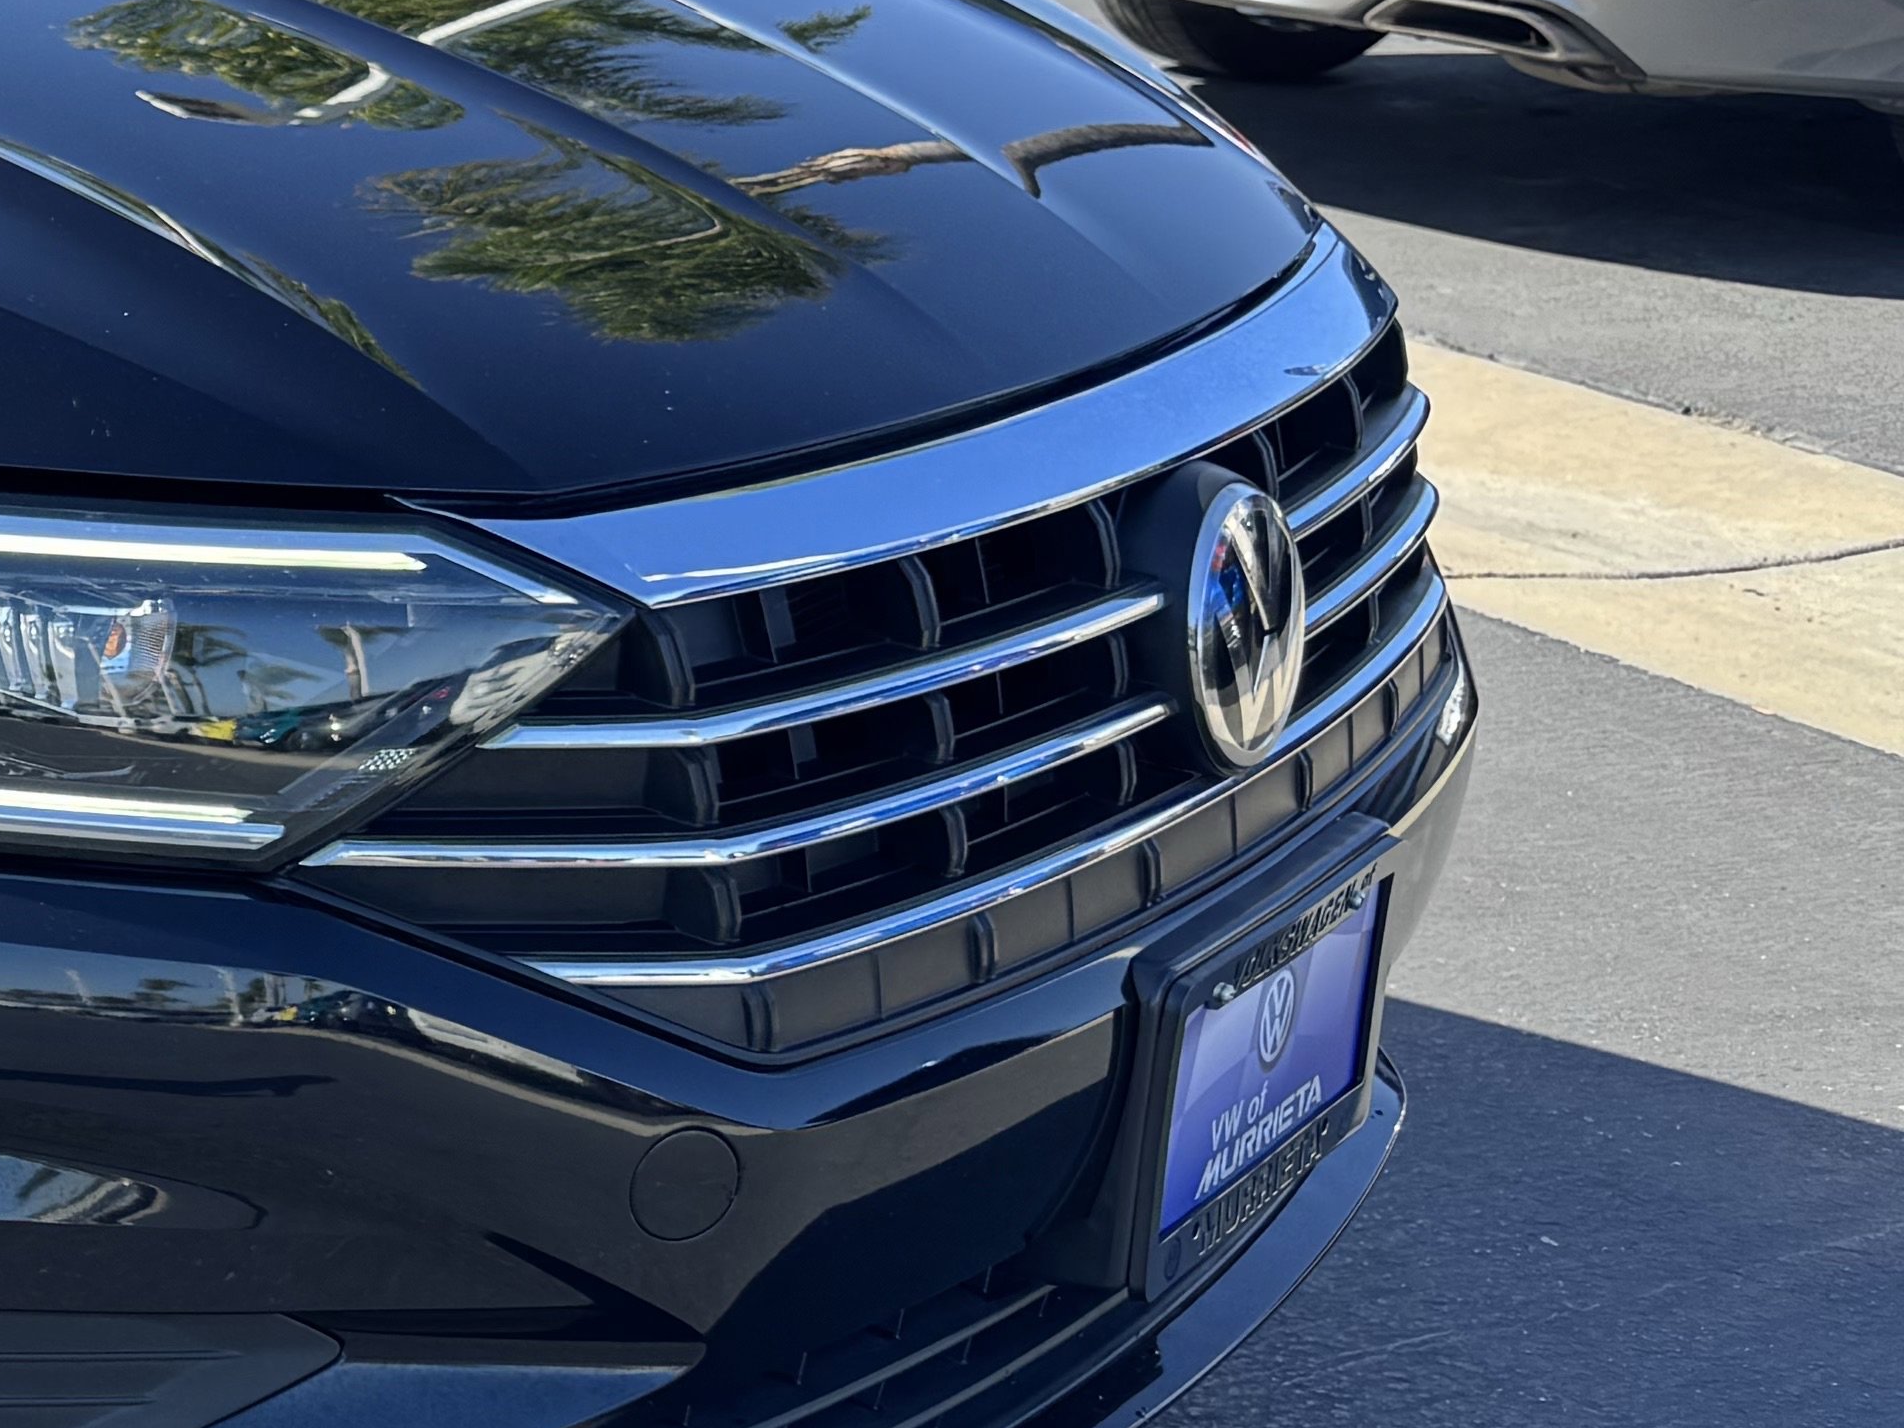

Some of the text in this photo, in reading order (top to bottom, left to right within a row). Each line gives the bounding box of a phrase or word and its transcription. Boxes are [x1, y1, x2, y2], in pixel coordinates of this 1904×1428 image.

[1194, 1075, 1322, 1200] MURRIETA
[1212, 1080, 1269, 1152] VW of
